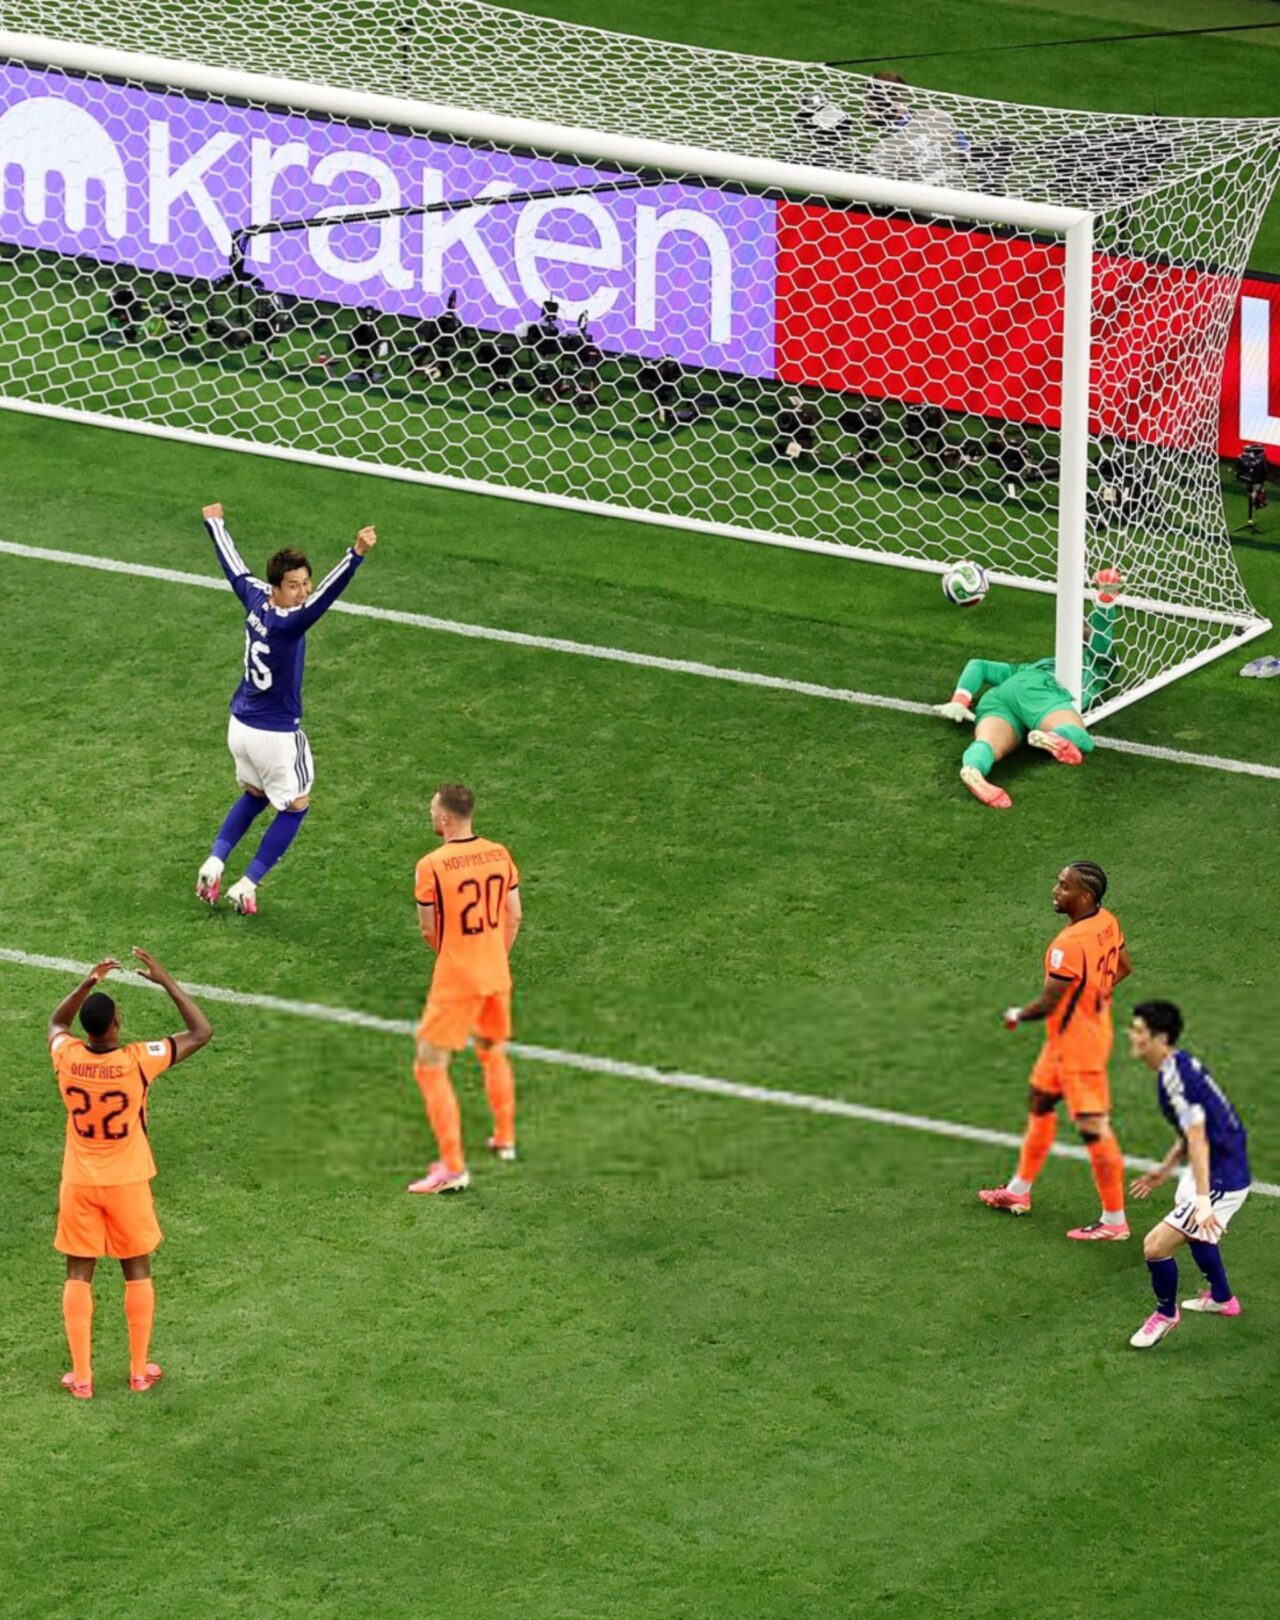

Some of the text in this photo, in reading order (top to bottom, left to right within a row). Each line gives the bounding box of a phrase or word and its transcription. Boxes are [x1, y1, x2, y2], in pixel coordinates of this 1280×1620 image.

[148, 119, 732, 344] kraken
[244, 628, 272, 691] 15
[457, 874, 505, 935] 20
[66, 1086, 129, 1139] 22
